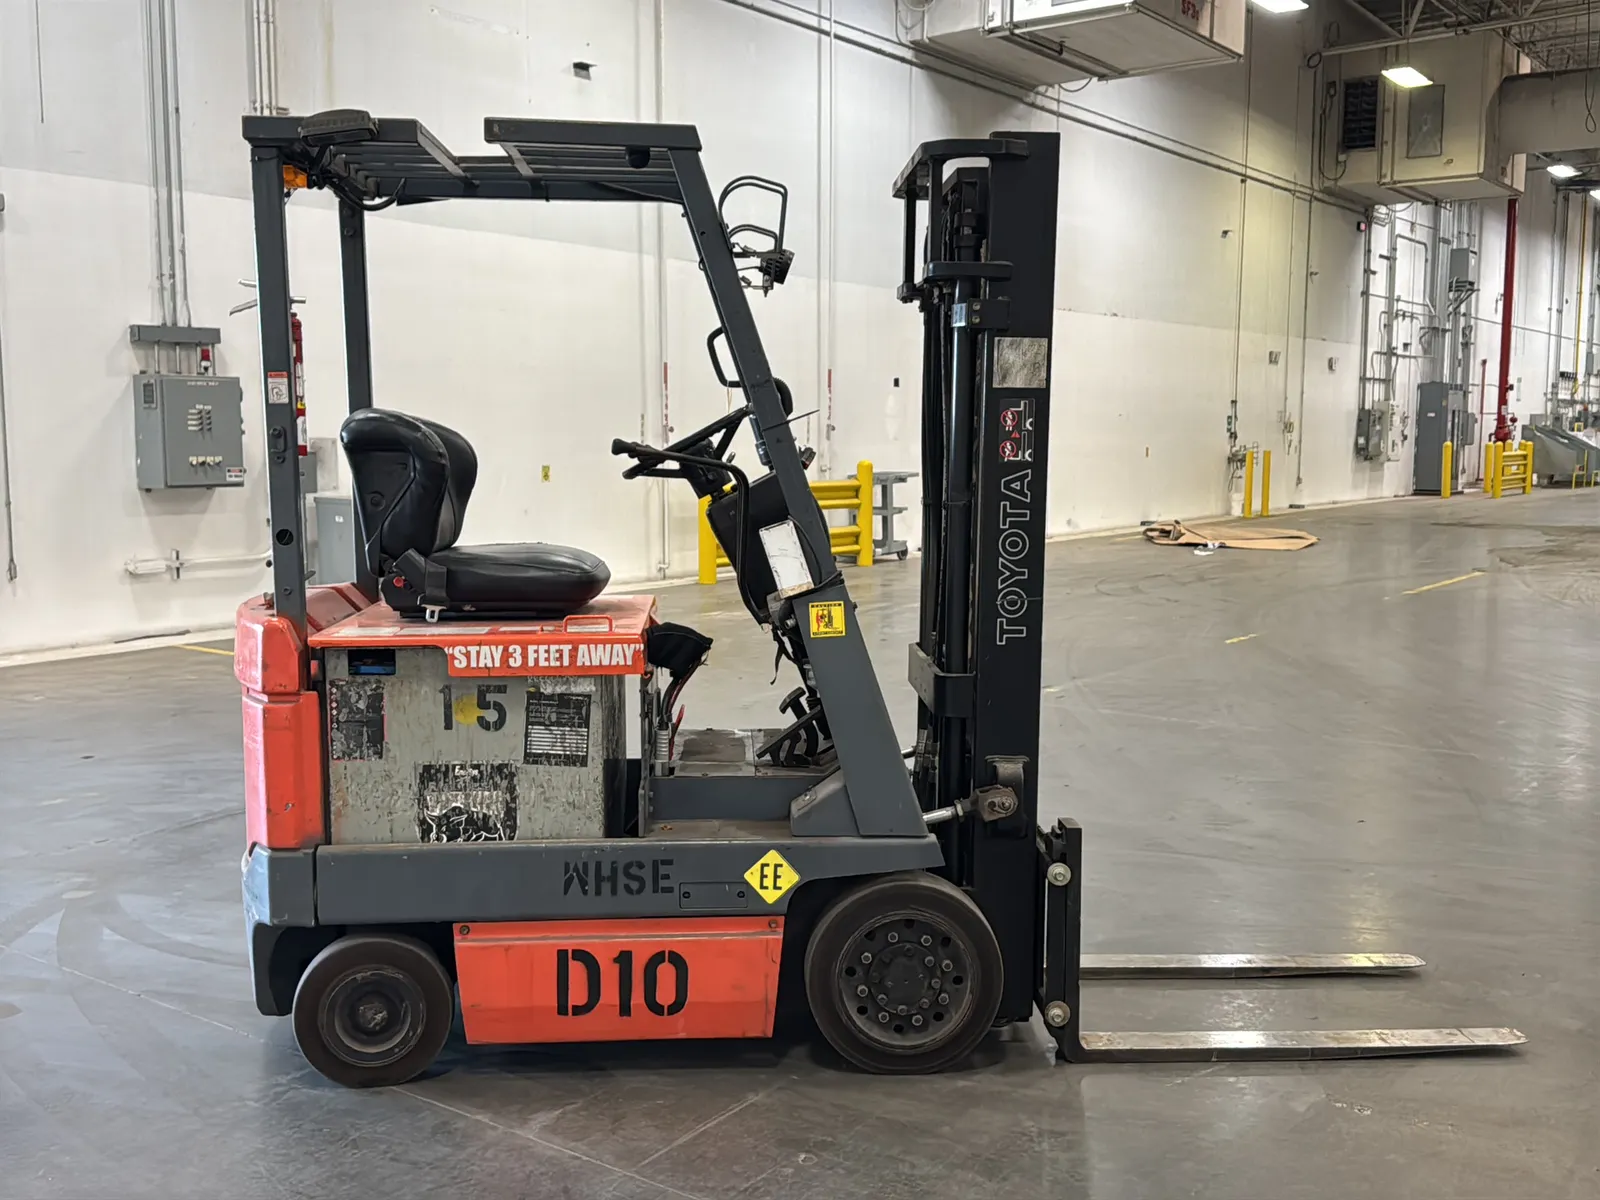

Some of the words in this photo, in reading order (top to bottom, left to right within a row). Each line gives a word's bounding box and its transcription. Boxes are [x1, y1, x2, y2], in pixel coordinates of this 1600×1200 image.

[997, 469, 1032, 645] TOYOTA
[444, 644, 504, 668] “STAY
[508, 644, 523, 668] 3
[527, 643, 573, 667] FEET
[576, 642, 645, 667] AWAY”
[563, 858, 675, 896] WHSE
[759, 862, 784, 891] EE
[556, 948, 689, 1017] D10
